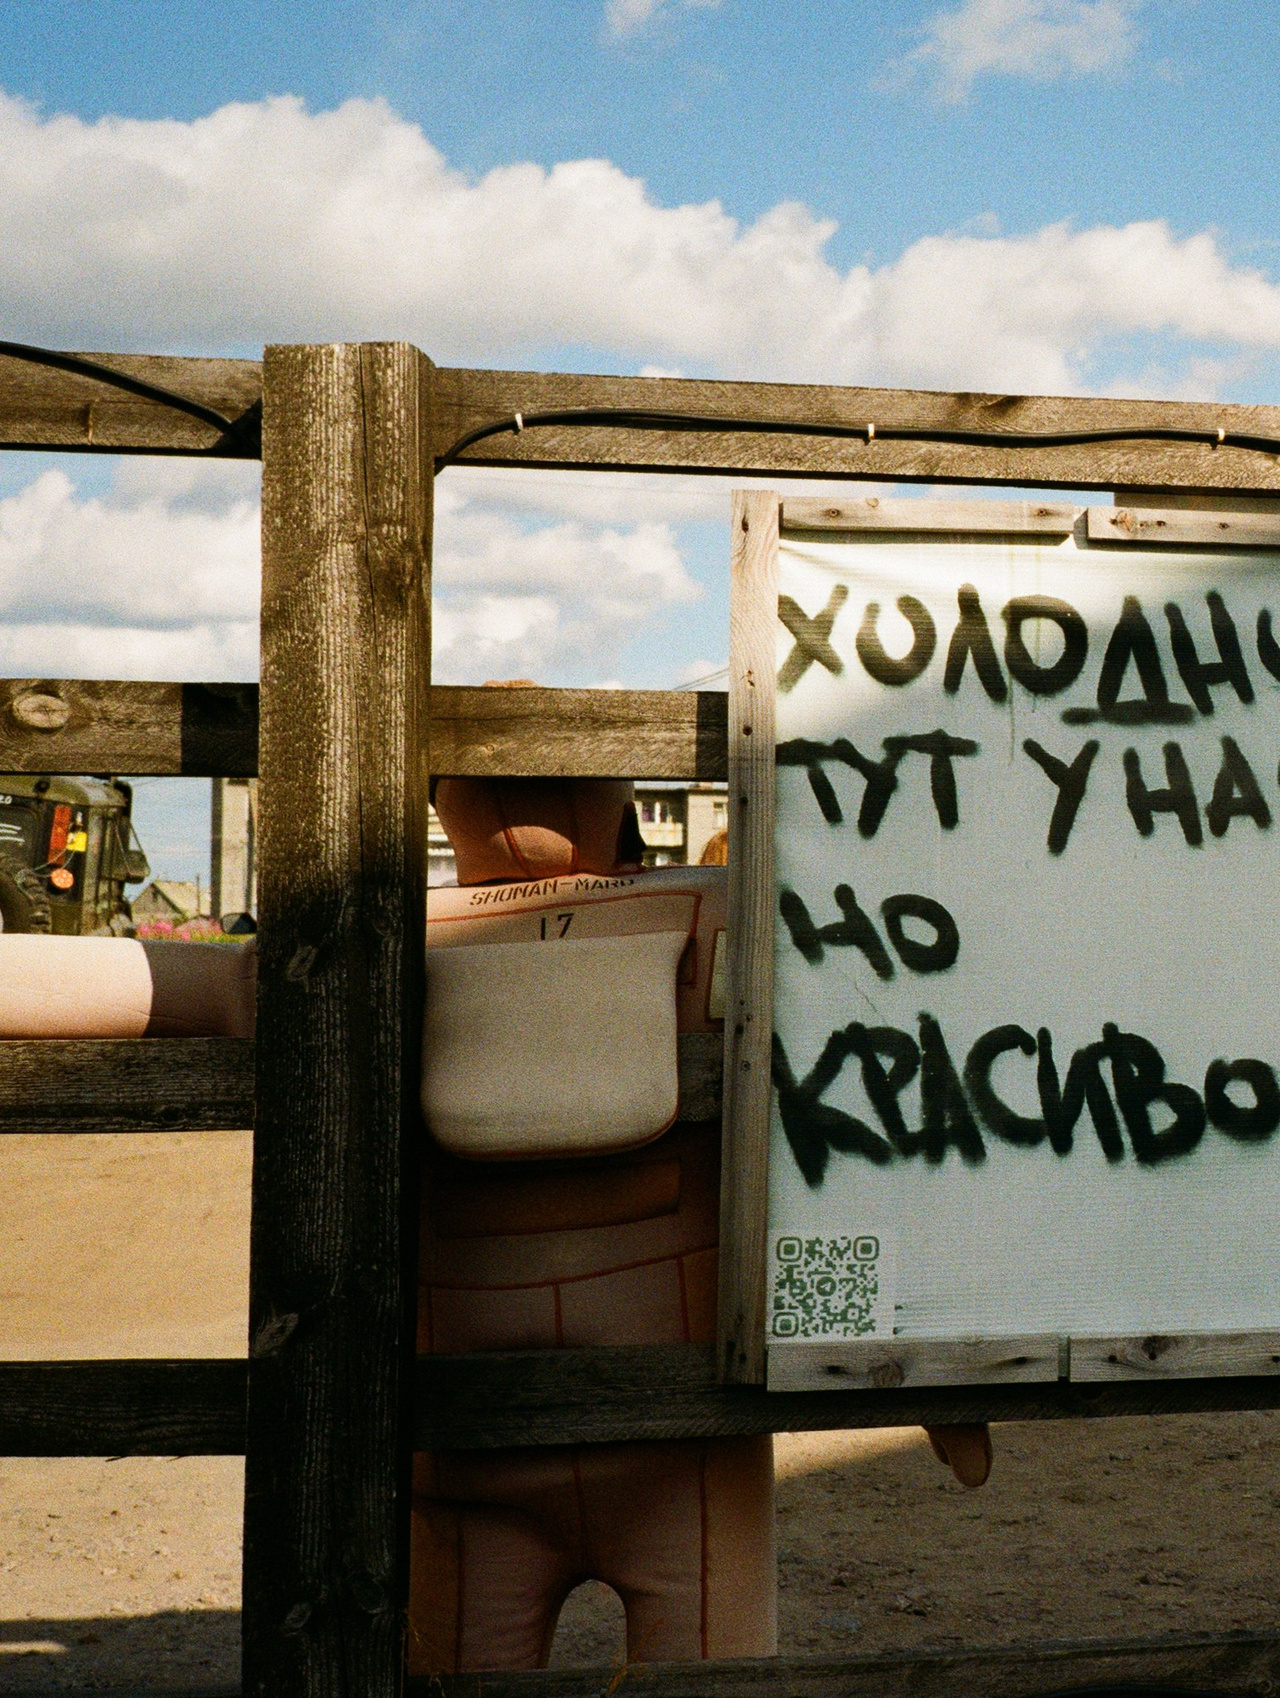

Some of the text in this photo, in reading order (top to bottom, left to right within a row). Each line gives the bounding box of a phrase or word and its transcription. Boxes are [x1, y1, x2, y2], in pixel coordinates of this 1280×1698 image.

[776, 729, 980, 840] ТУТ
[540, 912, 575, 941] 17
[779, 883, 960, 981] НО
